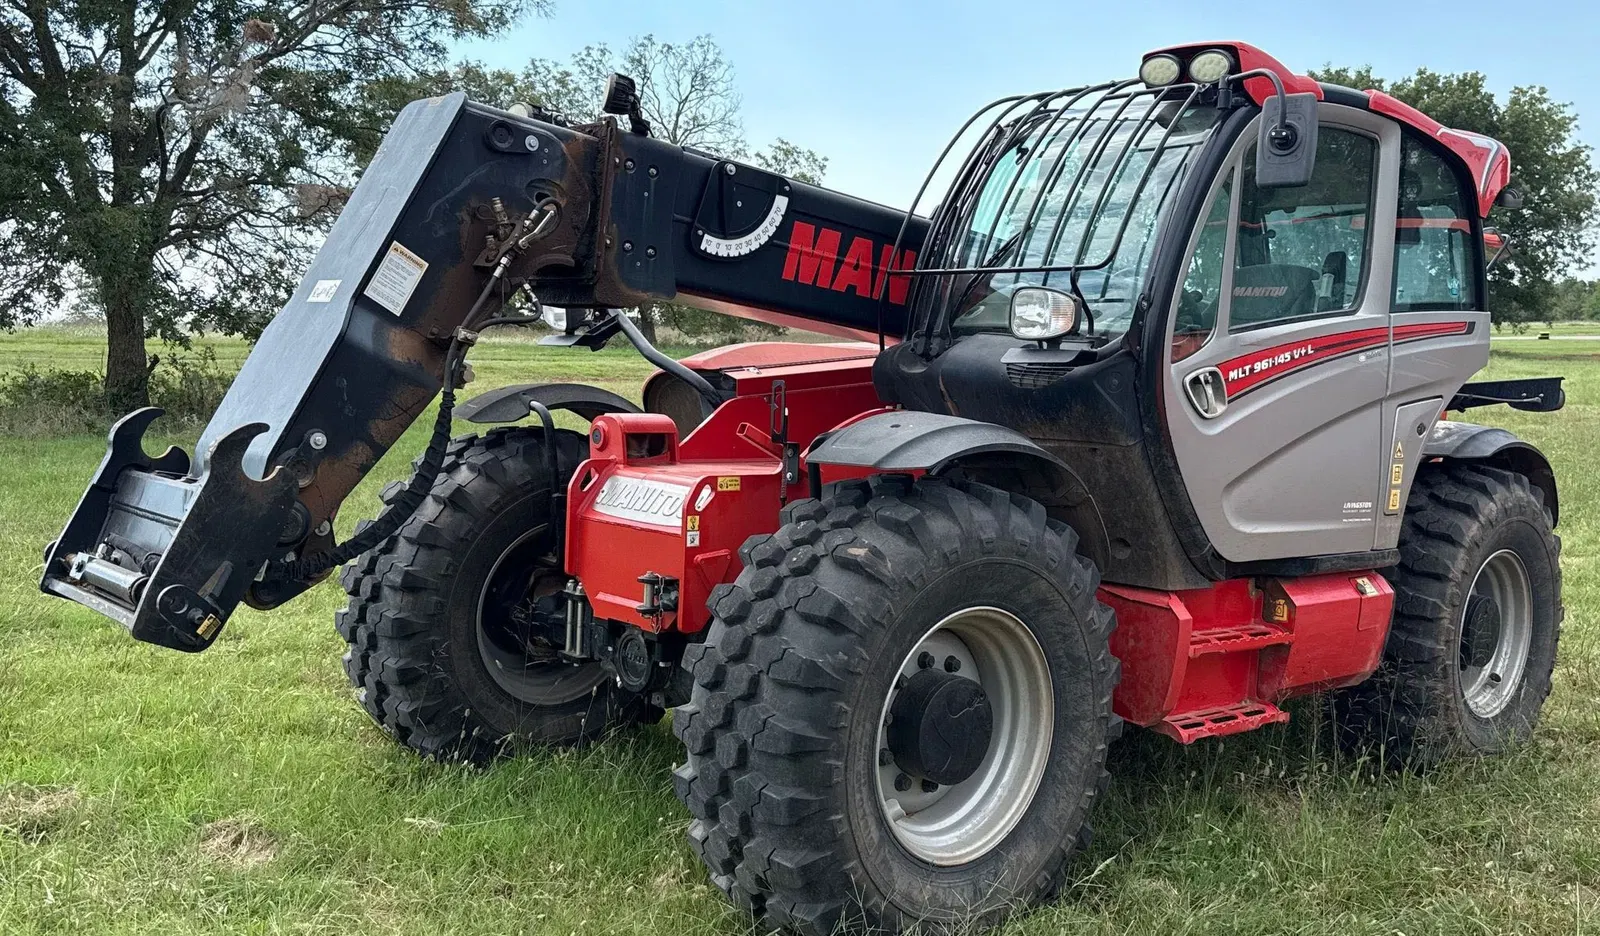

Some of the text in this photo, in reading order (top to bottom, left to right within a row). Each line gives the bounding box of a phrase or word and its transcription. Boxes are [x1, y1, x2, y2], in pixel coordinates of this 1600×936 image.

[400, 250, 424, 268] WARNING
[1232, 286, 1288, 297] MANITOU
[1228, 365, 1252, 382] MLT
[596, 482, 684, 520] MANITO
